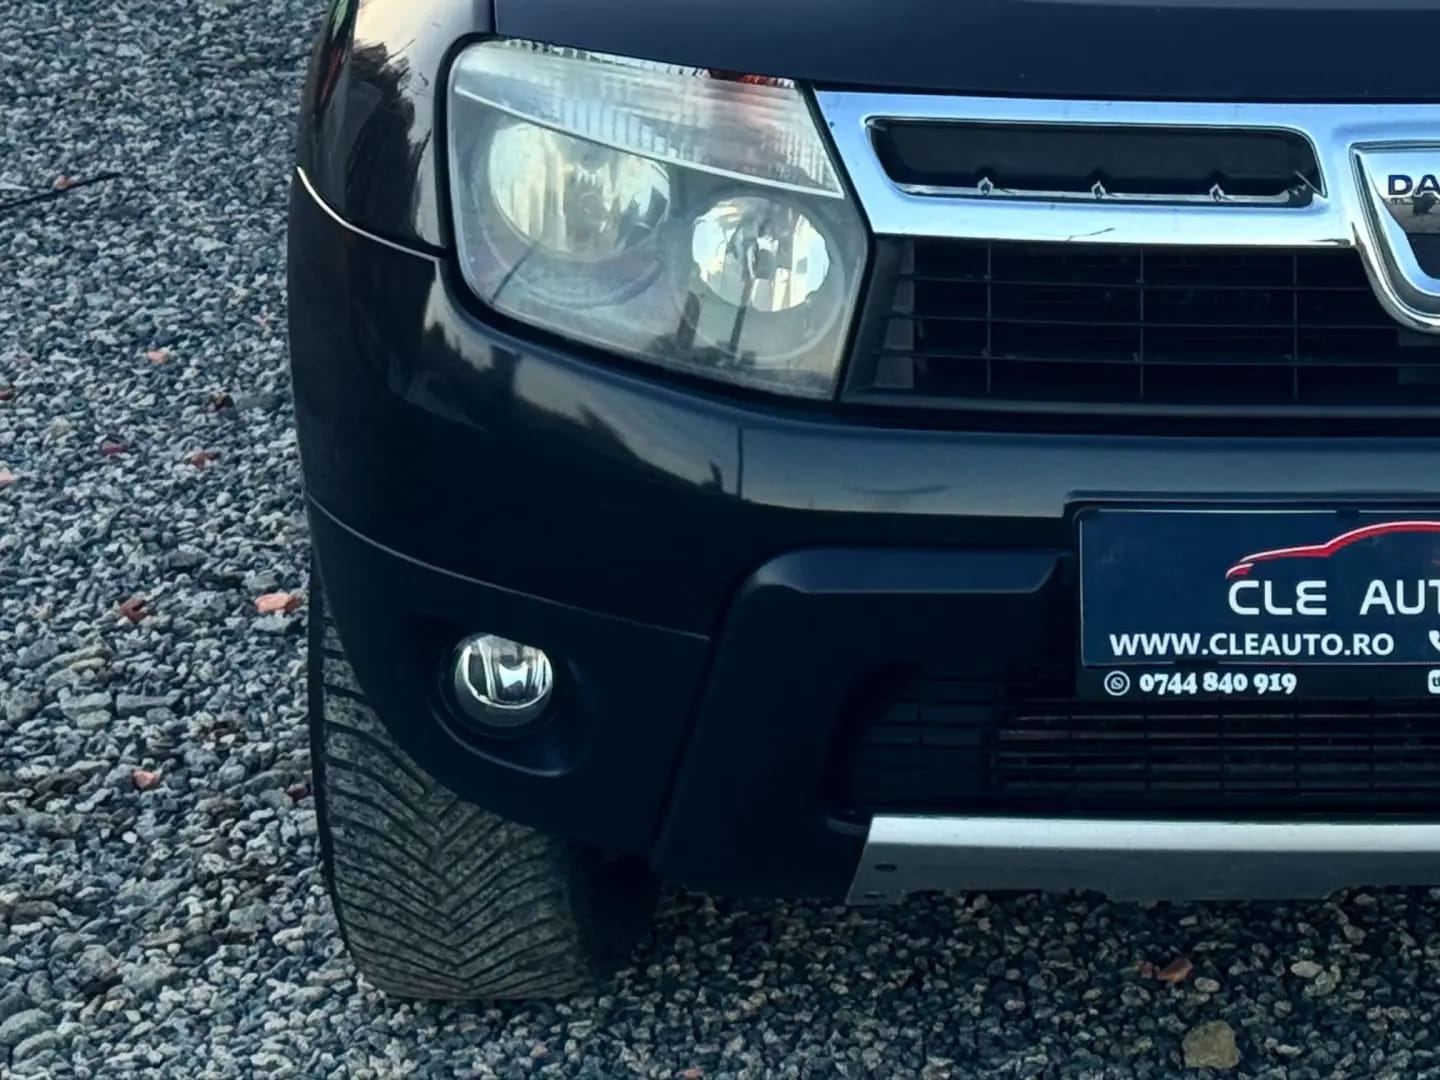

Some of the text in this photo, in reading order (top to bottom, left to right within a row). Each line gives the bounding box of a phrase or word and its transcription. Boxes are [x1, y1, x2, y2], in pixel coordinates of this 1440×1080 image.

[1228, 579, 1328, 616] CLE
[1109, 632, 1395, 656] WWW.CLEAUTO.RO
[1138, 671, 1298, 696] 0744 840 919
